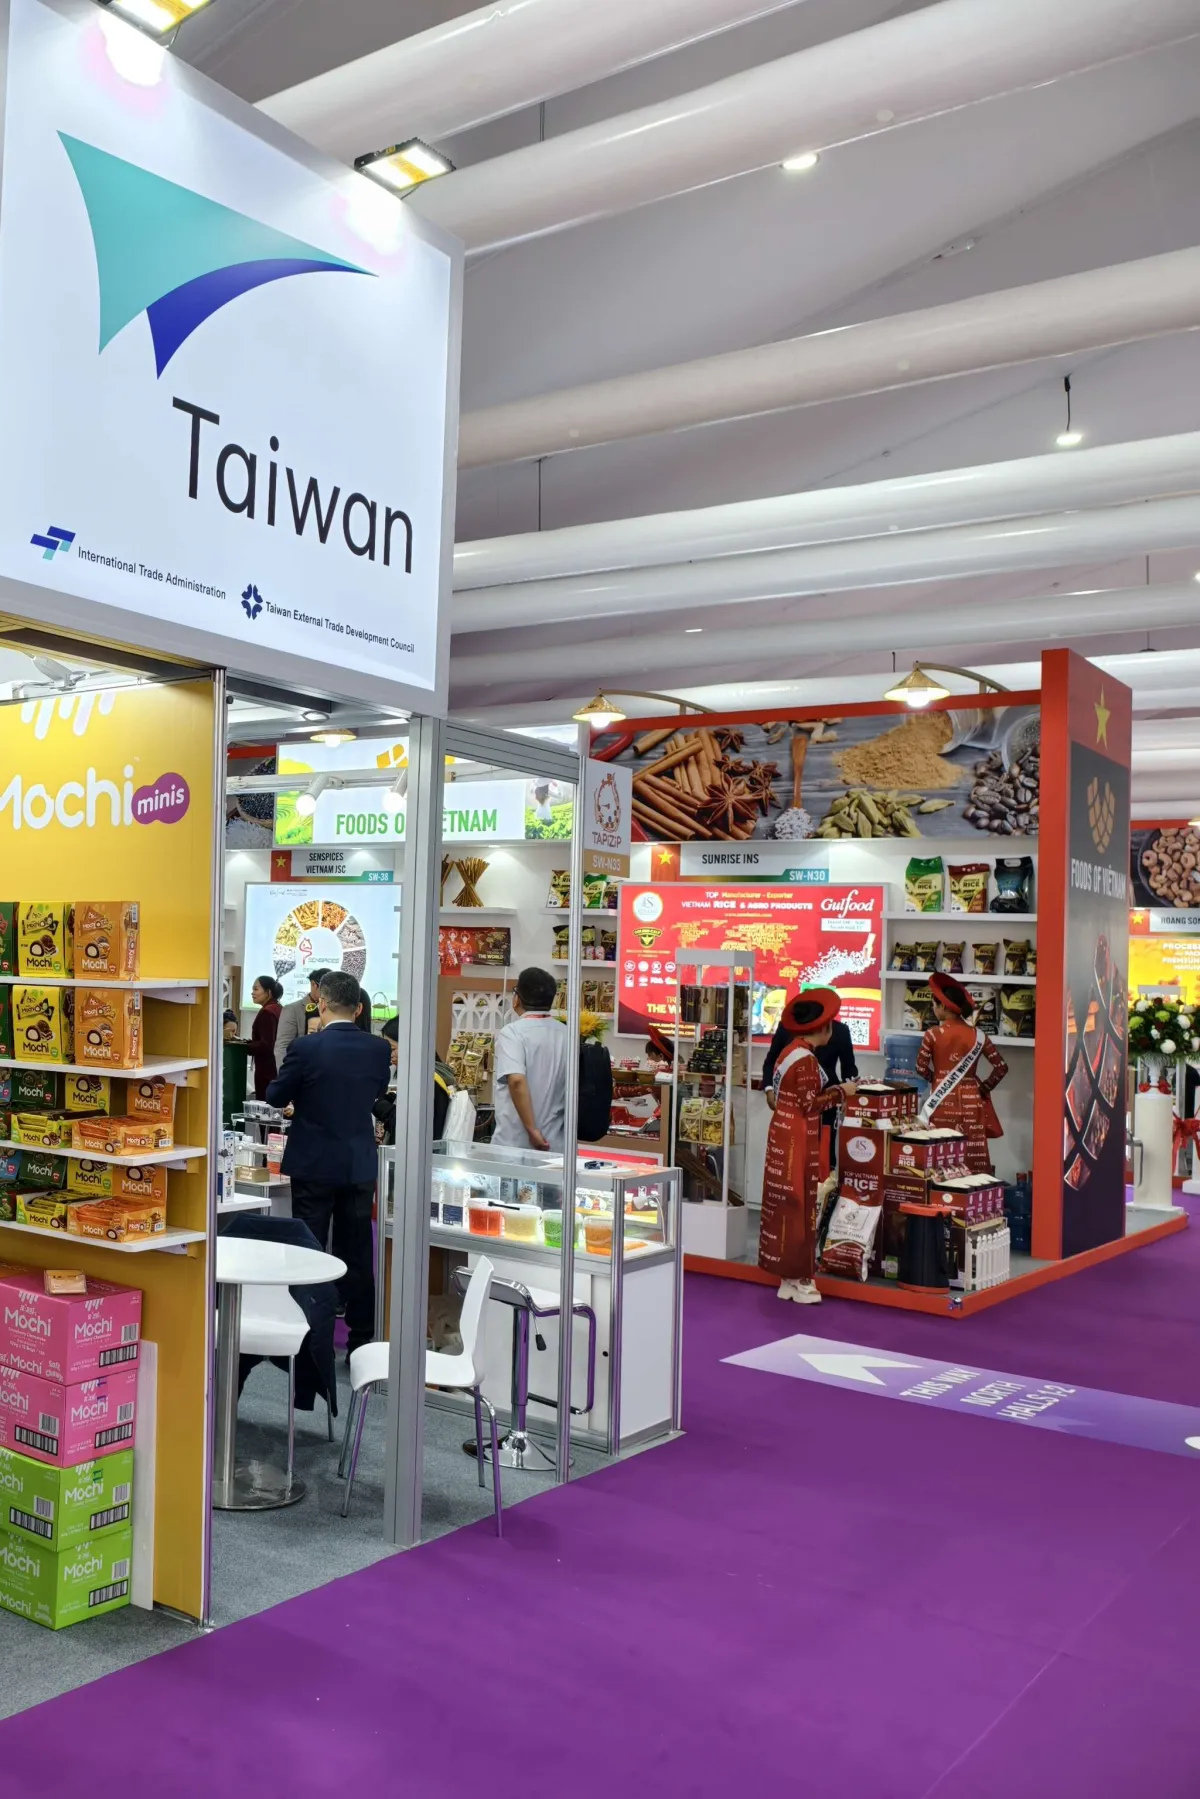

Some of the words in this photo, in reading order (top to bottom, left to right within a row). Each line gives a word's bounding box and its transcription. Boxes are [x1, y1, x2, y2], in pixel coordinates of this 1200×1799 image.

[172, 396, 413, 573] Taiwan
[78, 546, 137, 575] International
[139, 564, 163, 582] Trade
[166, 572, 226, 599] Administration
[265, 601, 292, 619] Taiwan
[294, 609, 323, 627] External
[325, 618, 344, 634] Trade
[346, 624, 389, 647] Development
[390, 637, 415, 653] Council
[137, 785, 185, 816] minis
[336, 813, 388, 835] FOODS
[309, 853, 343, 861] SENSPICES
[593, 855, 620, 871] SW-N33
[702, 854, 739, 865] SUNRISE
[741, 853, 759, 864] INS
[306, 866, 334, 874] VIETNAM
[335, 865, 346, 874] JSC
[368, 873, 388, 881] SW-38
[789, 870, 826, 882] SW-N30
[1072, 858, 1091, 891] FOODS
[1094, 865, 1101, 894] OF
[771, 902, 813, 910] PRODUCTS
[821, 889, 874, 918] Gulfood
[26, 957, 52, 968] Mochi
[647, 1004, 666, 1013] THE
[23, 1042, 49, 1053] Mochi
[927, 1097, 938, 1109] MS.
[936, 1073, 959, 1098] FRAGANT
[956, 1056, 973, 1074] WHITE
[972, 1041, 982, 1057] RICE
[18, 1086, 44, 1097] Mochi
[844, 1177, 878, 1192] RICE
[4, 1307, 52, 1337] Mochi
[74, 1316, 113, 1340] Mochi
[899, 1381, 953, 1399] THIS
[931, 1368, 981, 1384] WAY
[960, 1380, 1026, 1407] NORTH
[996, 1394, 1059, 1420] HALLS
[65, 1480, 104, 1505] Mochi
